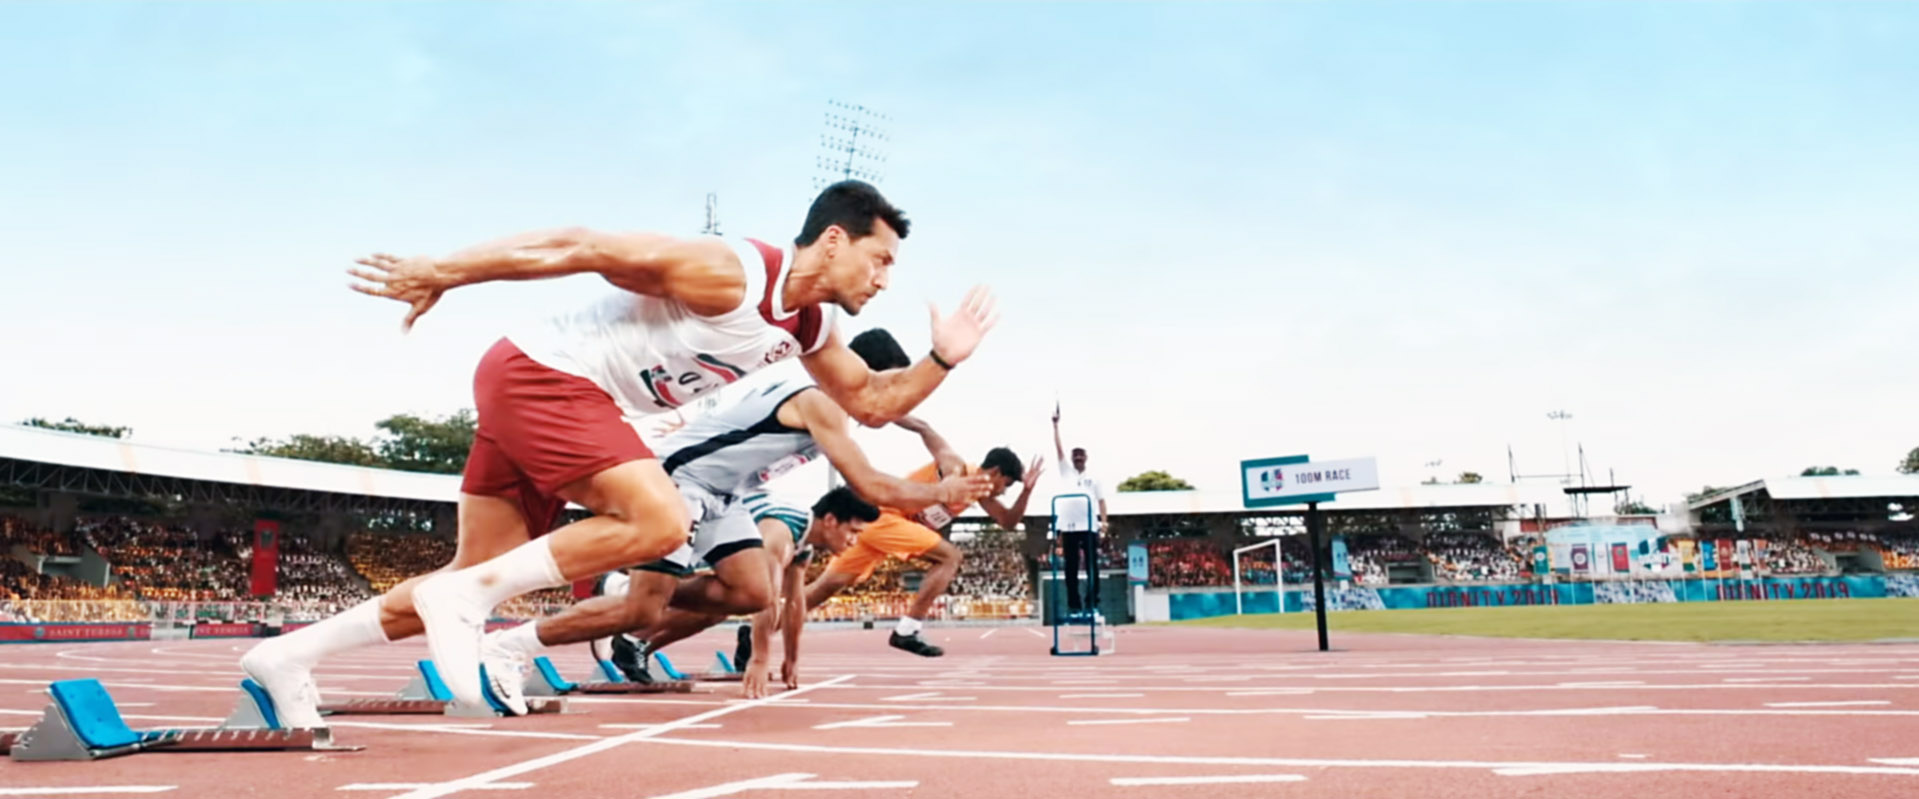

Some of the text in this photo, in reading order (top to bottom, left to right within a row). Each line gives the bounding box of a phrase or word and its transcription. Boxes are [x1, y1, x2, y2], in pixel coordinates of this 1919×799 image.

[1295, 469, 1351, 484] 100M RACE
[1801, 581, 1850, 599] 2019
